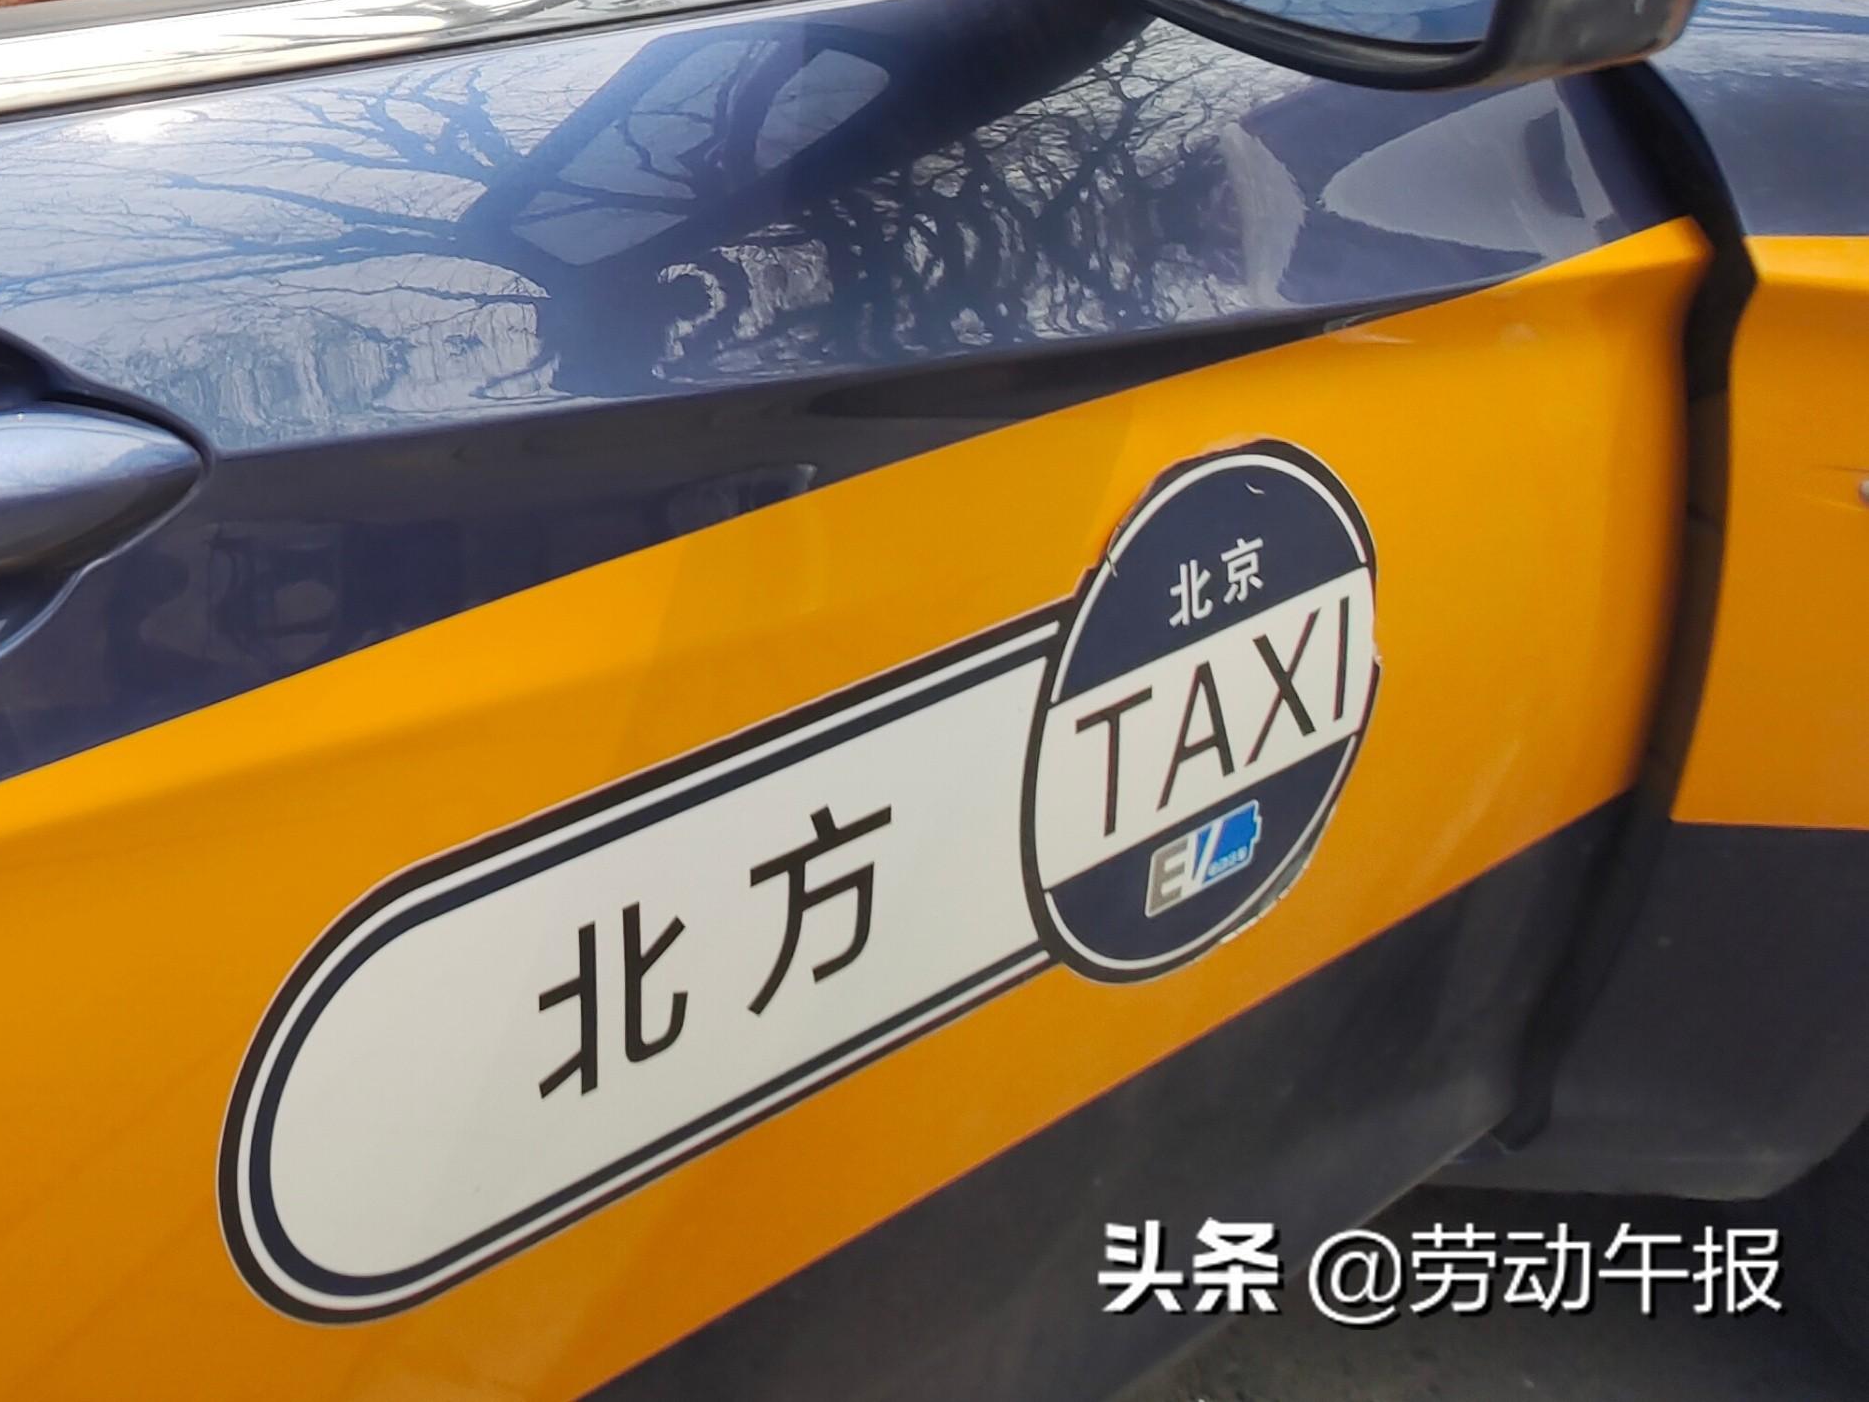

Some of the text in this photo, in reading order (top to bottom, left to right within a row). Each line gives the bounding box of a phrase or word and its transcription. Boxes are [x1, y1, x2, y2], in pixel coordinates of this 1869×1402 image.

[1169, 537, 1265, 628] 北京
[1075, 595, 1350, 838] TAXI
[539, 803, 892, 1099] 北方
